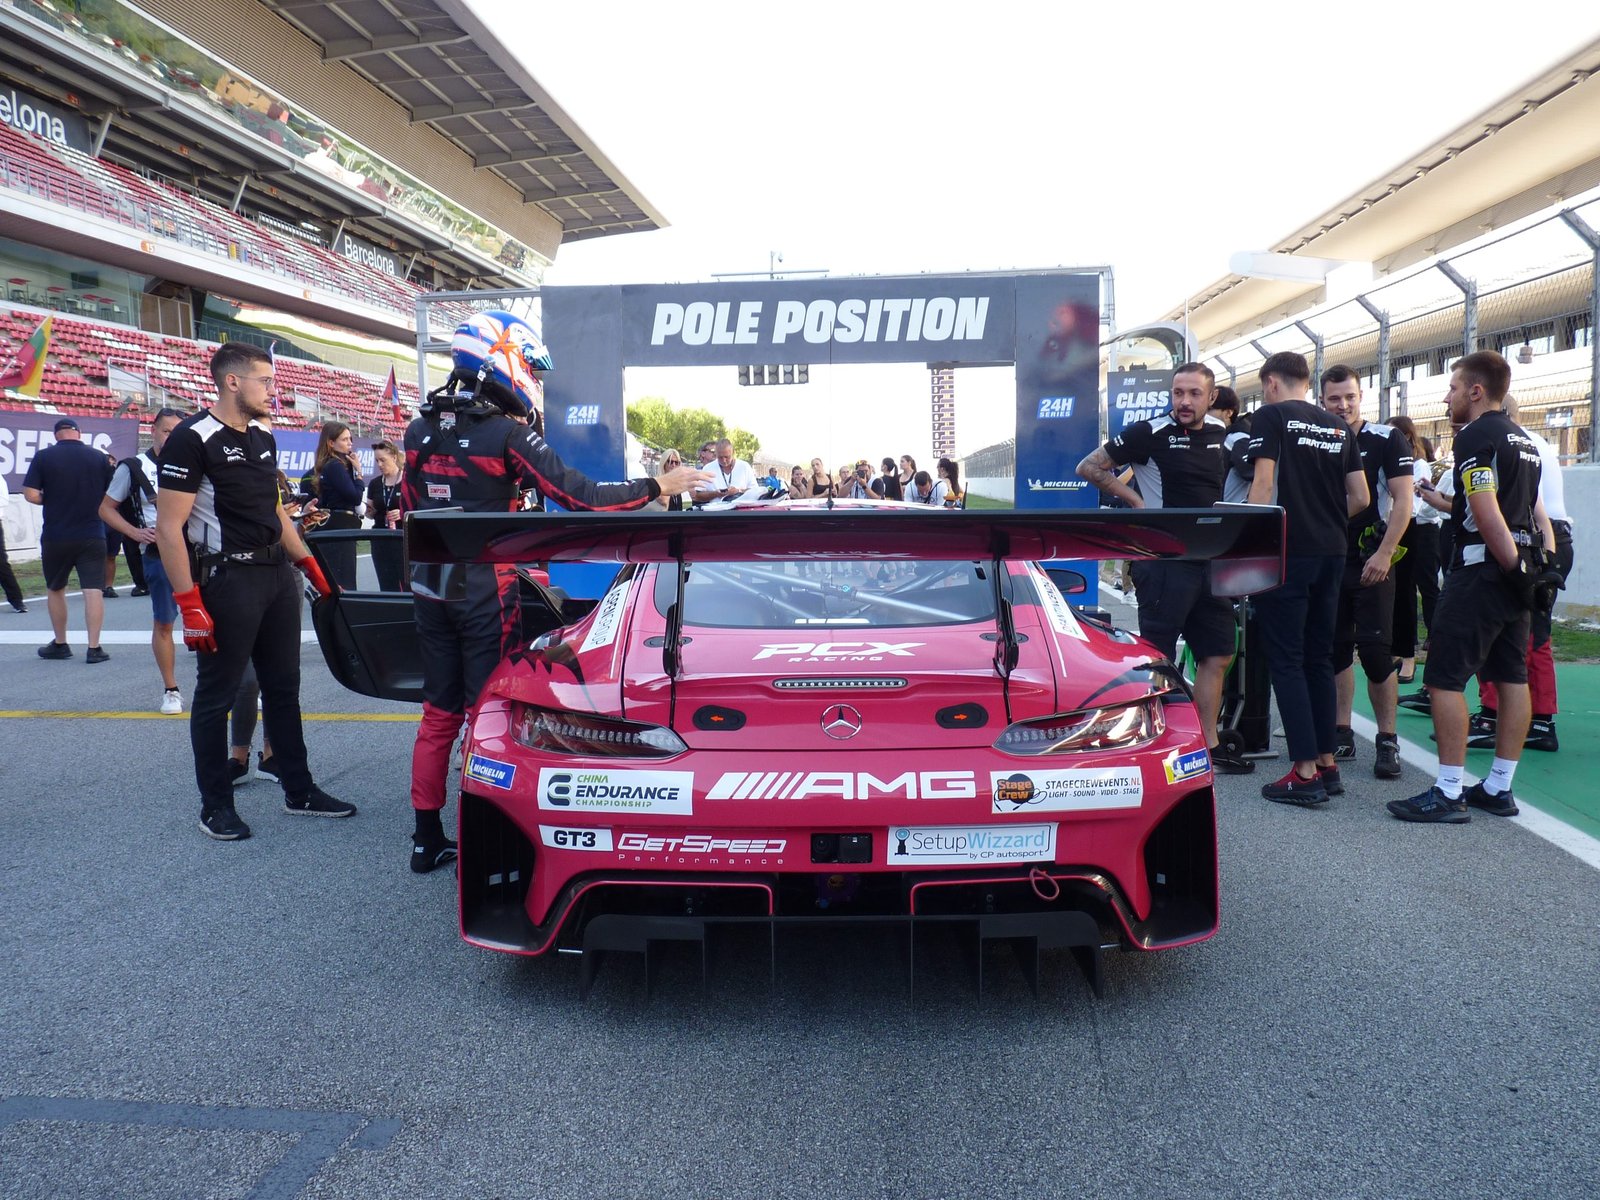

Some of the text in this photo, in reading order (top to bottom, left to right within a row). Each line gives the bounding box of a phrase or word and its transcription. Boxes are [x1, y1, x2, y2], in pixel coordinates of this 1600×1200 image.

[344, 235, 395, 275] Barcelona
[651, 297, 990, 345] POLE POSITION
[1040, 397, 1073, 412] 24H
[1116, 390, 1170, 409] CLASS
[567, 405, 599, 418] 24H
[752, 642, 927, 660] PCX
[473, 763, 506, 780] MICHELIN
[577, 774, 609, 783] CHINA
[790, 770, 976, 800] AMG
[997, 778, 1033, 791] Stage
[1045, 777, 1141, 790] STAGECREWEVENTS.NL
[575, 784, 680, 801] ENDURANCE
[998, 790, 1030, 800] Crew
[1048, 787, 1140, 799] LIGHT SOUND VIDEO STAGE
[575, 799, 653, 808] CHAMPIONSHIP
[553, 830, 596, 848] GT3
[912, 830, 1045, 852] SetupWizzard
[980, 851, 994, 859] CP
[996, 850, 1044, 858] autosport
